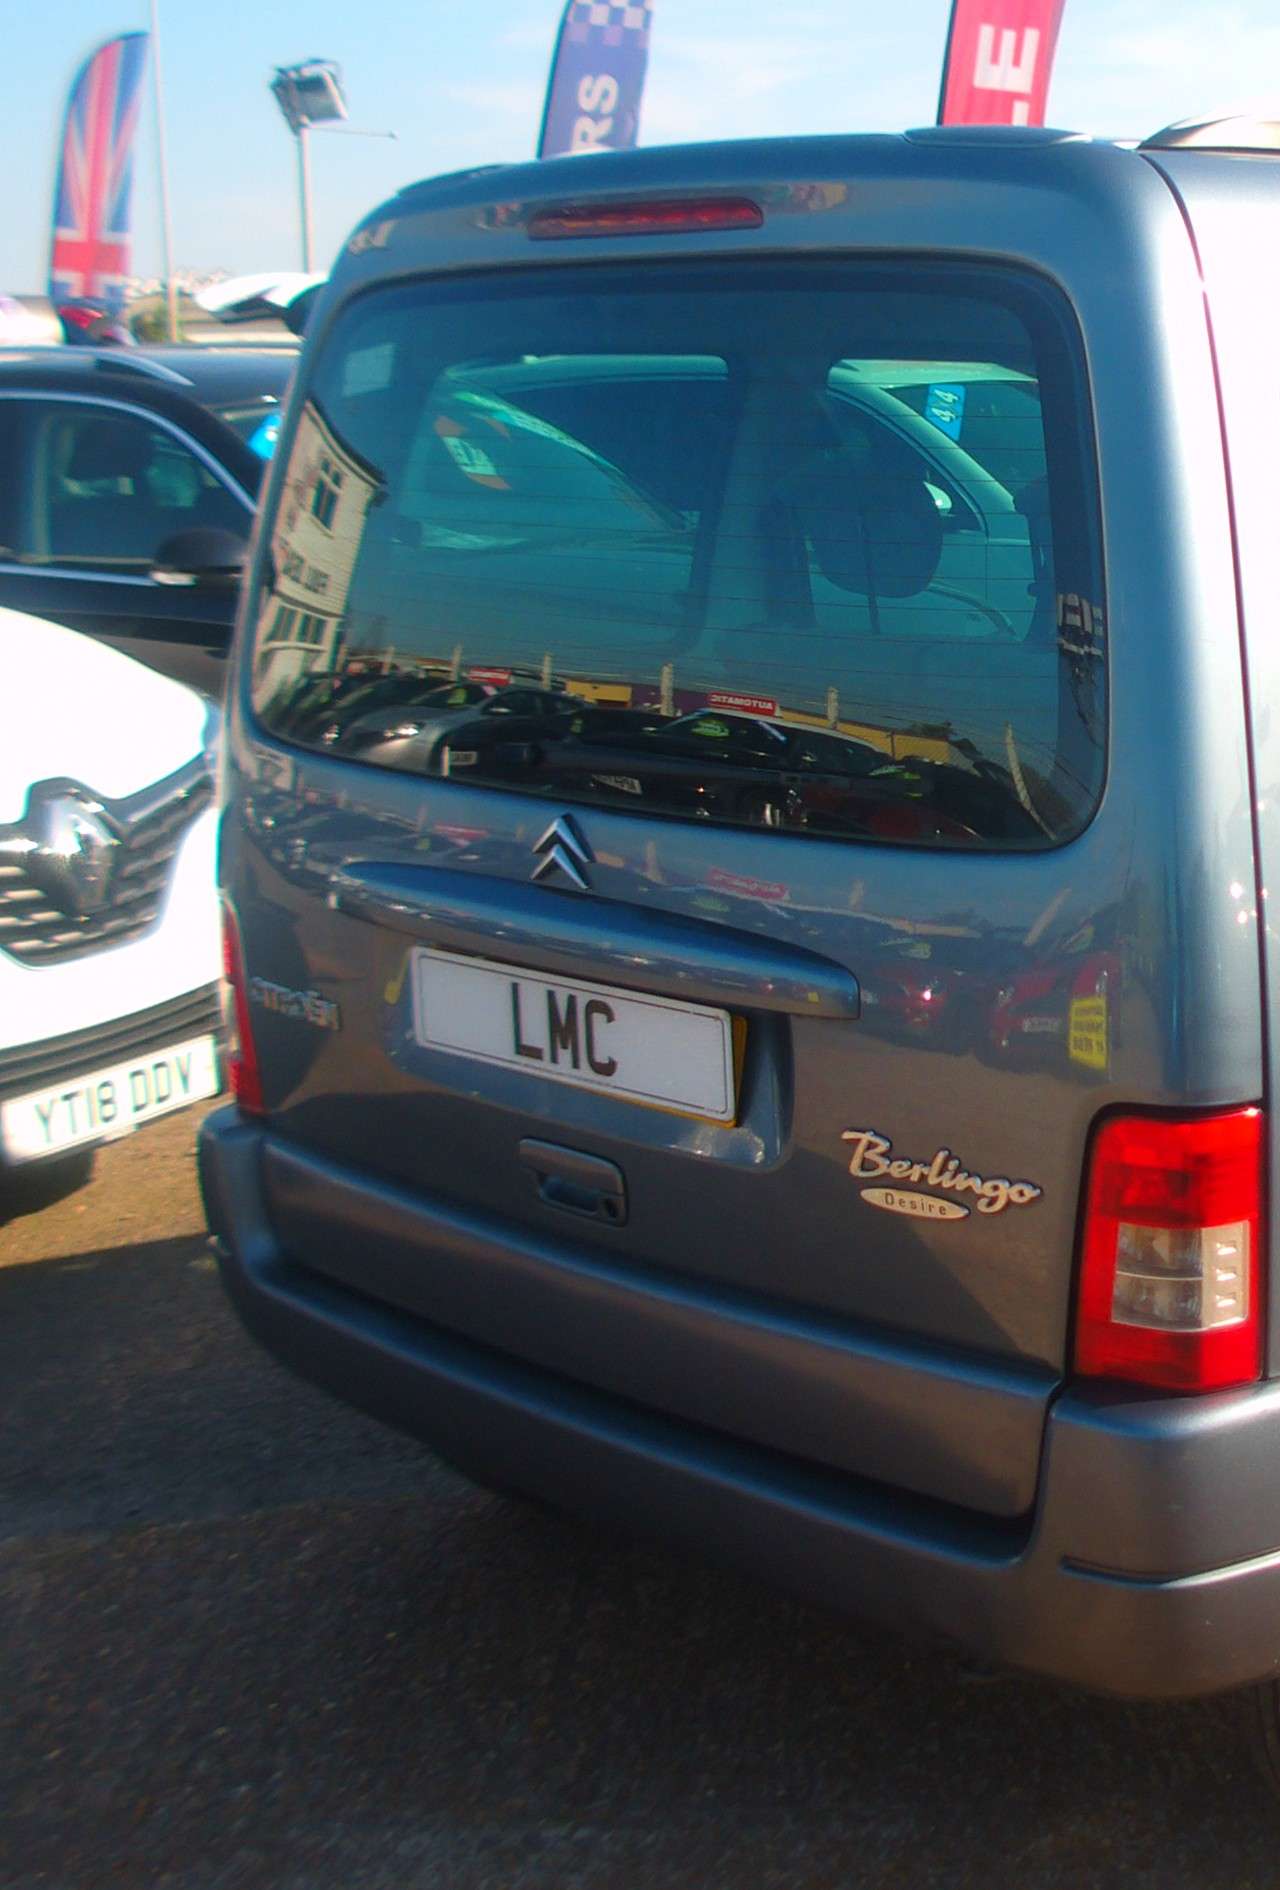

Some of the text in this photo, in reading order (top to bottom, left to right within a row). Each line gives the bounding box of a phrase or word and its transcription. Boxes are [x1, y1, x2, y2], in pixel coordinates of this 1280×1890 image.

[511, 981, 618, 1077] LMC
[34, 1051, 192, 1144] YT18 DDY
[841, 1129, 1042, 1214] Berlingo
[883, 1191, 948, 1216] Desire
